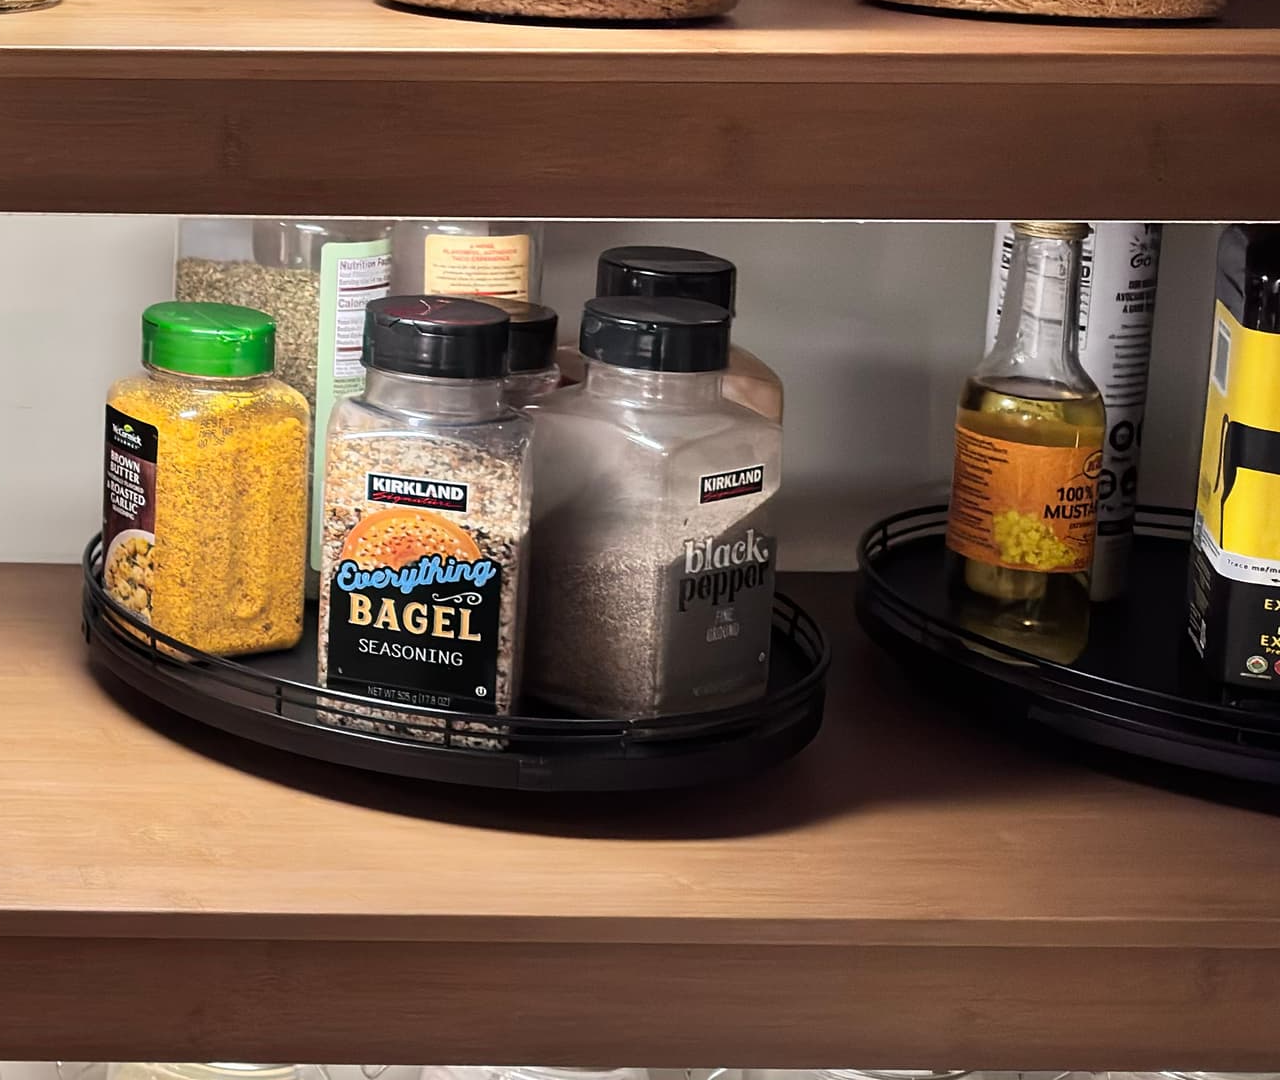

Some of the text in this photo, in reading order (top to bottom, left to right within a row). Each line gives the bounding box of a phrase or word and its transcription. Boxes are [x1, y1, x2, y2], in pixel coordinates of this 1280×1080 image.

[110, 449, 141, 474] BROWN
[110, 461, 140, 485] BUTTER
[110, 480, 146, 506] ROASTED
[372, 476, 465, 501] KIRKLAND
[703, 468, 762, 493] KIRKLAND
[110, 492, 138, 515] GARLIC
[684, 528, 769, 575] black
[337, 555, 497, 594] Everything
[347, 591, 482, 642] BAGEL
[358, 637, 464, 667] SEASONING
